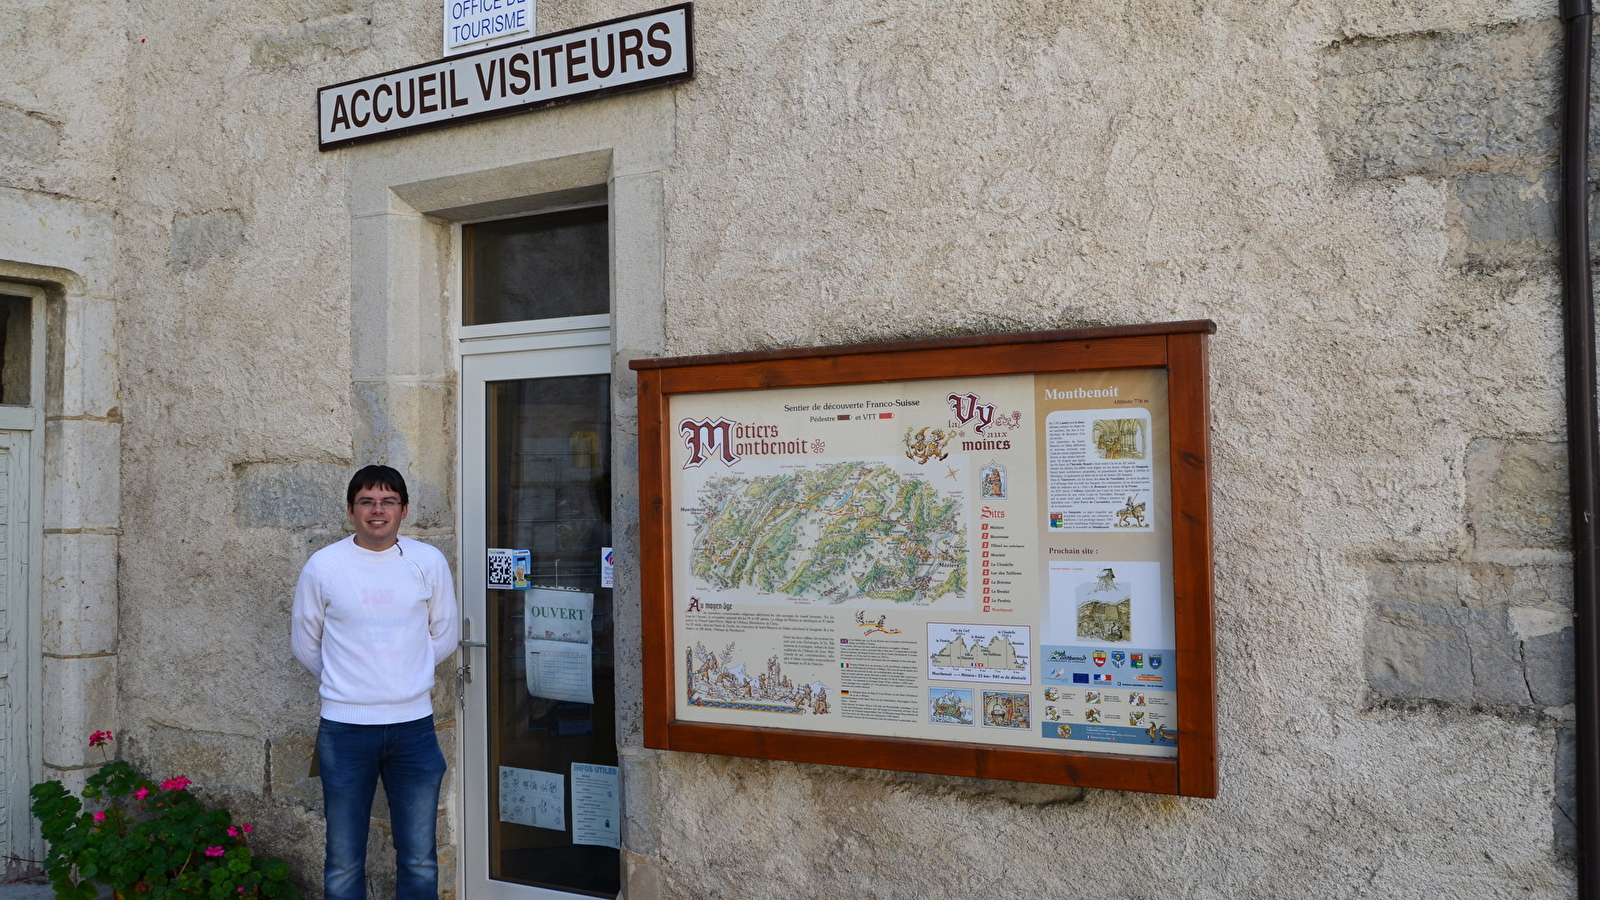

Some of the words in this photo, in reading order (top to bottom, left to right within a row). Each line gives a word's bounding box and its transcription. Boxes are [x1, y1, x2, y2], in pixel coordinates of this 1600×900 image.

[452, 9, 525, 42] TOURISME
[330, 68, 468, 133] ACCUEIL
[474, 22, 672, 102] VISITEURS
[1044, 386, 1118, 400] Montbenoit
[823, 402, 864, 410] découverte
[866, 399, 920, 408] Franco-Suisse
[962, 439, 1011, 451] moines
[981, 506, 1005, 519] Sites
[531, 606, 585, 620] OUVERT
[574, 764, 594, 773] INFOS
[594, 767, 617, 775] UTILES
